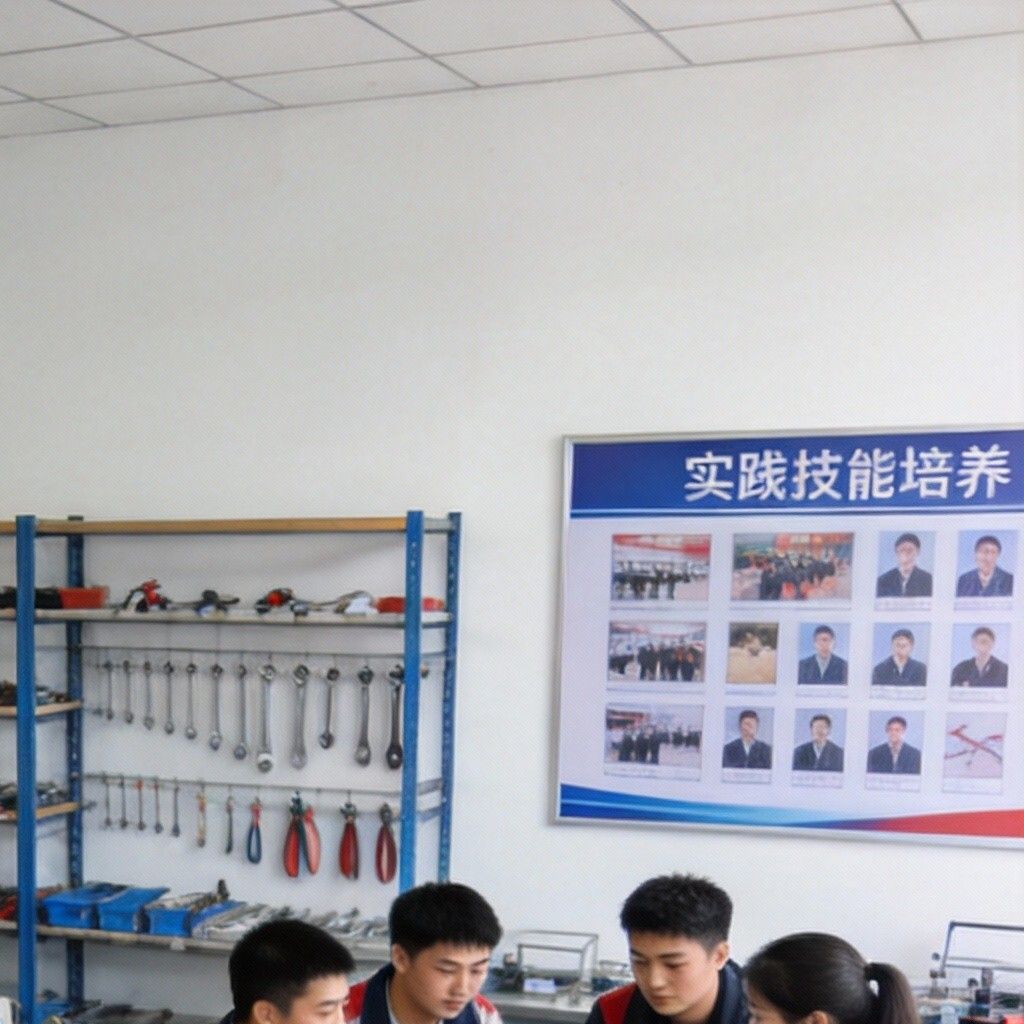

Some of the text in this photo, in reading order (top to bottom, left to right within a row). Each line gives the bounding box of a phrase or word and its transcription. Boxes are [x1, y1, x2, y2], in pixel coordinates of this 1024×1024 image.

[684, 444, 1011, 501] 实践技能培养
